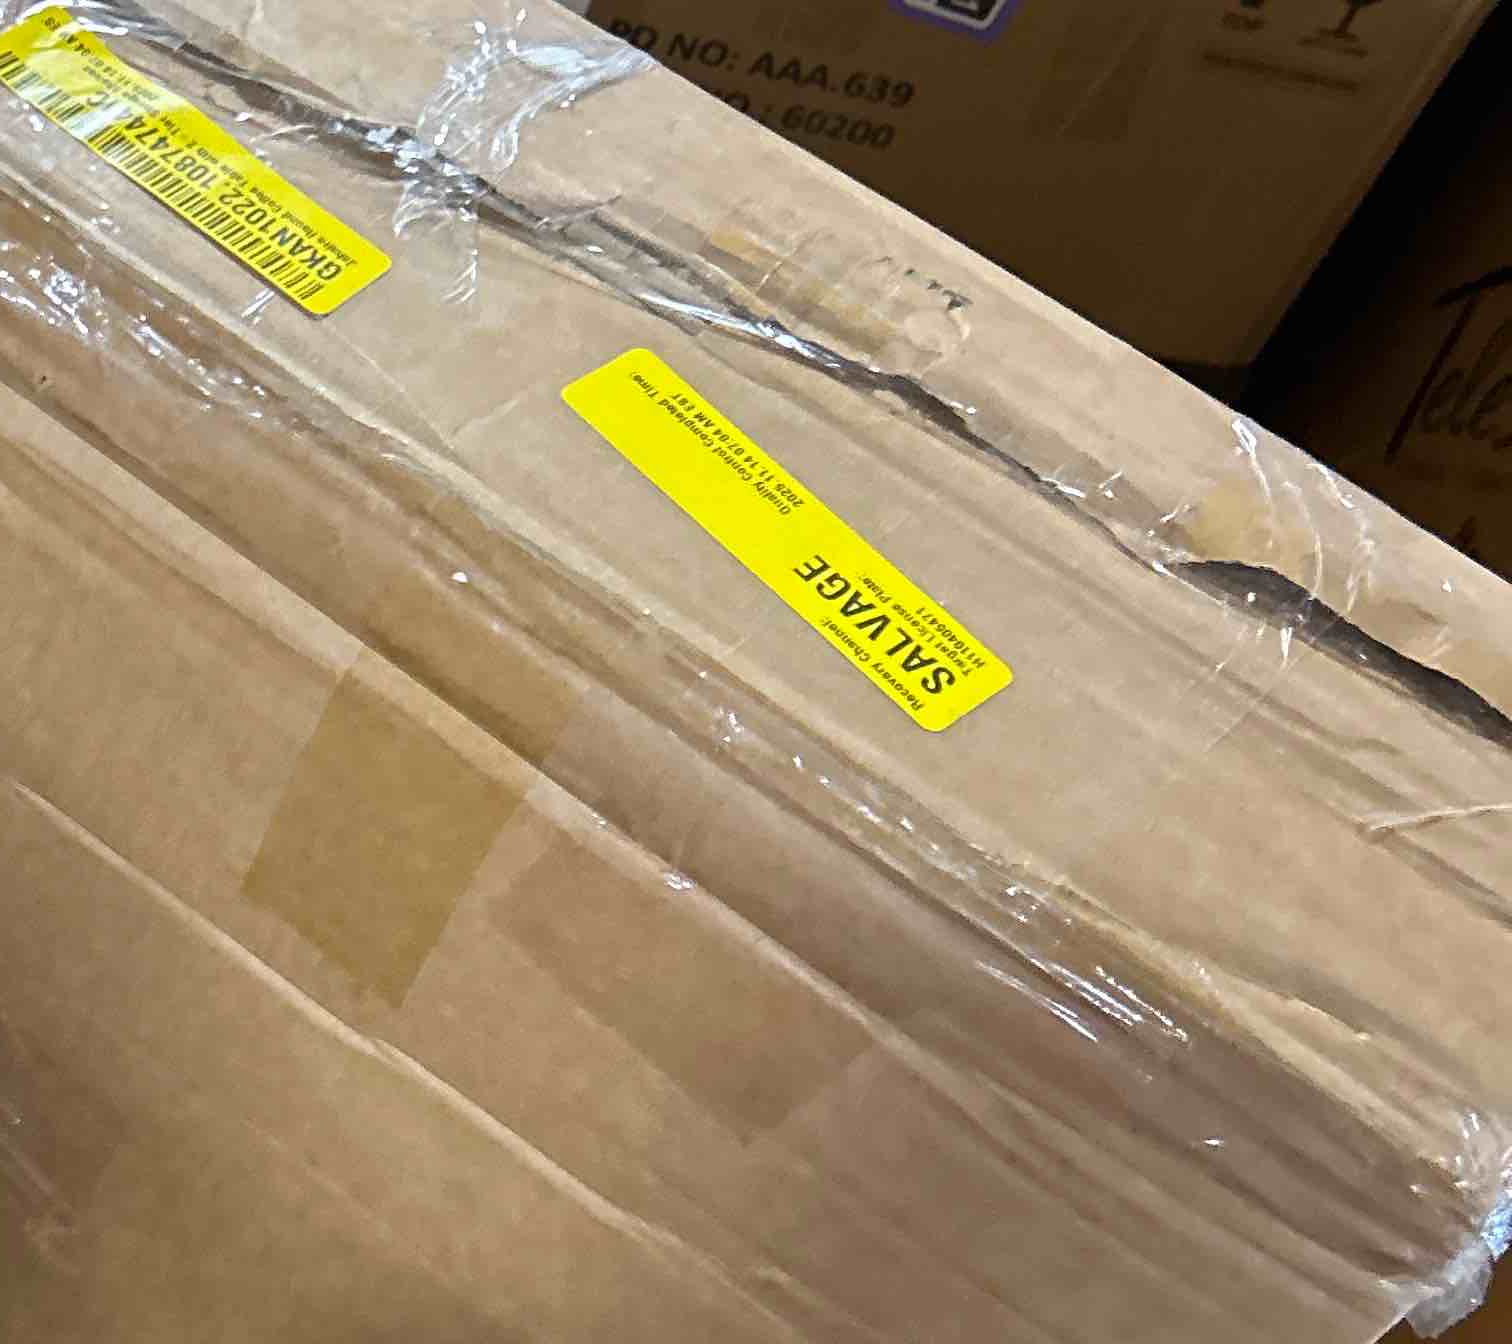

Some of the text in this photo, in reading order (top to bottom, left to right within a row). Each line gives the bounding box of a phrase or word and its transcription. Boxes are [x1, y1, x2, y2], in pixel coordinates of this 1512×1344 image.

[667, 32, 740, 71] NO:
[748, 51, 916, 109] AAA.639
[781, 104, 897, 150] 60200
[657, 398, 715, 448] Completed
[711, 445, 753, 482] Control
[753, 480, 792, 516] Quality
[792, 554, 957, 695] SALVAGE
[892, 603, 937, 644] License
[821, 617, 925, 712] Recovery Channel:
